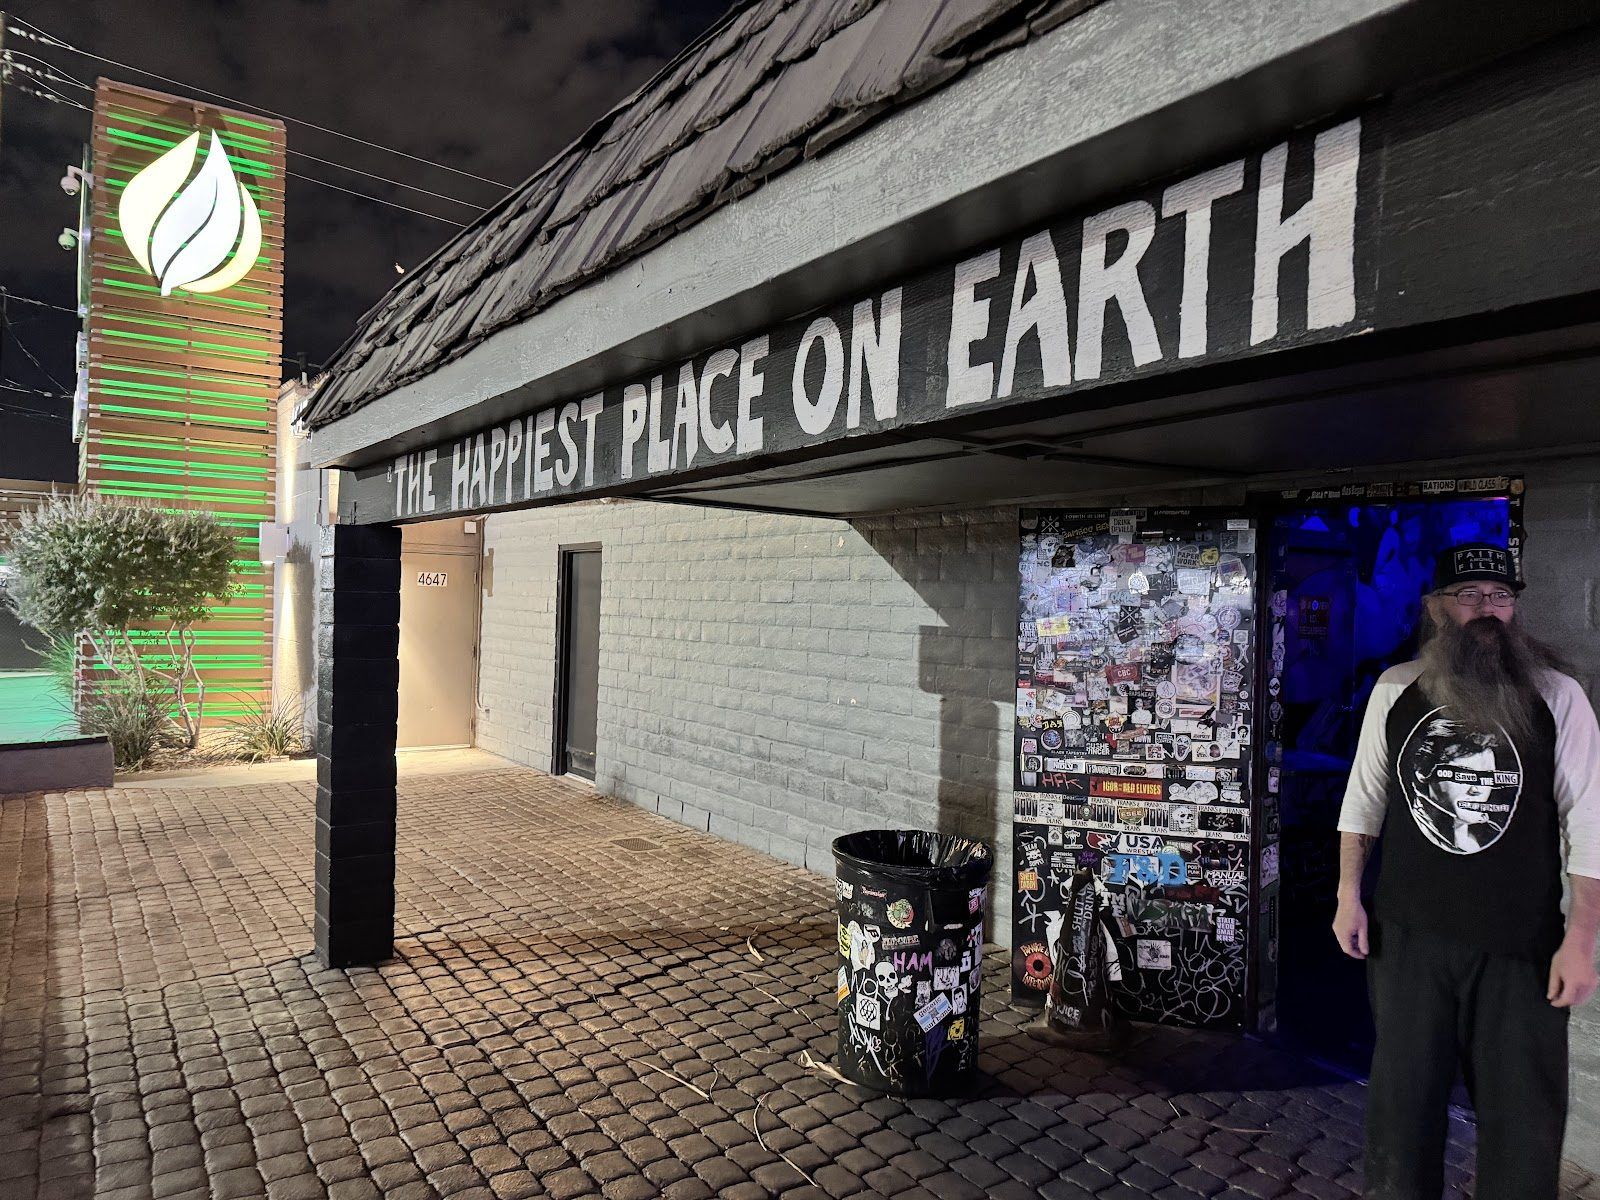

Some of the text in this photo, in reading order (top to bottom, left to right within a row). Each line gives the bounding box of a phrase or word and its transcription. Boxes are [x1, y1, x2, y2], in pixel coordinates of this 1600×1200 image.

[394, 117, 1362, 518] THE HAPPIEST PLACE ON EARTH
[1423, 479, 1455, 492] RATIONS
[1457, 551, 1503, 560] FAITH
[1458, 561, 1506, 571] FILTH
[418, 573, 447, 587] 4647
[1437, 769, 1453, 778] GOD
[1480, 778, 1494, 786] THE
[1494, 774, 1518, 784] KING
[1136, 783, 1161, 795] ELVISES
[1126, 834, 1163, 848] USA
[1206, 870, 1245, 879] MANUAL
[1071, 899, 1085, 931] SHUT
[893, 951, 933, 976] HAM
